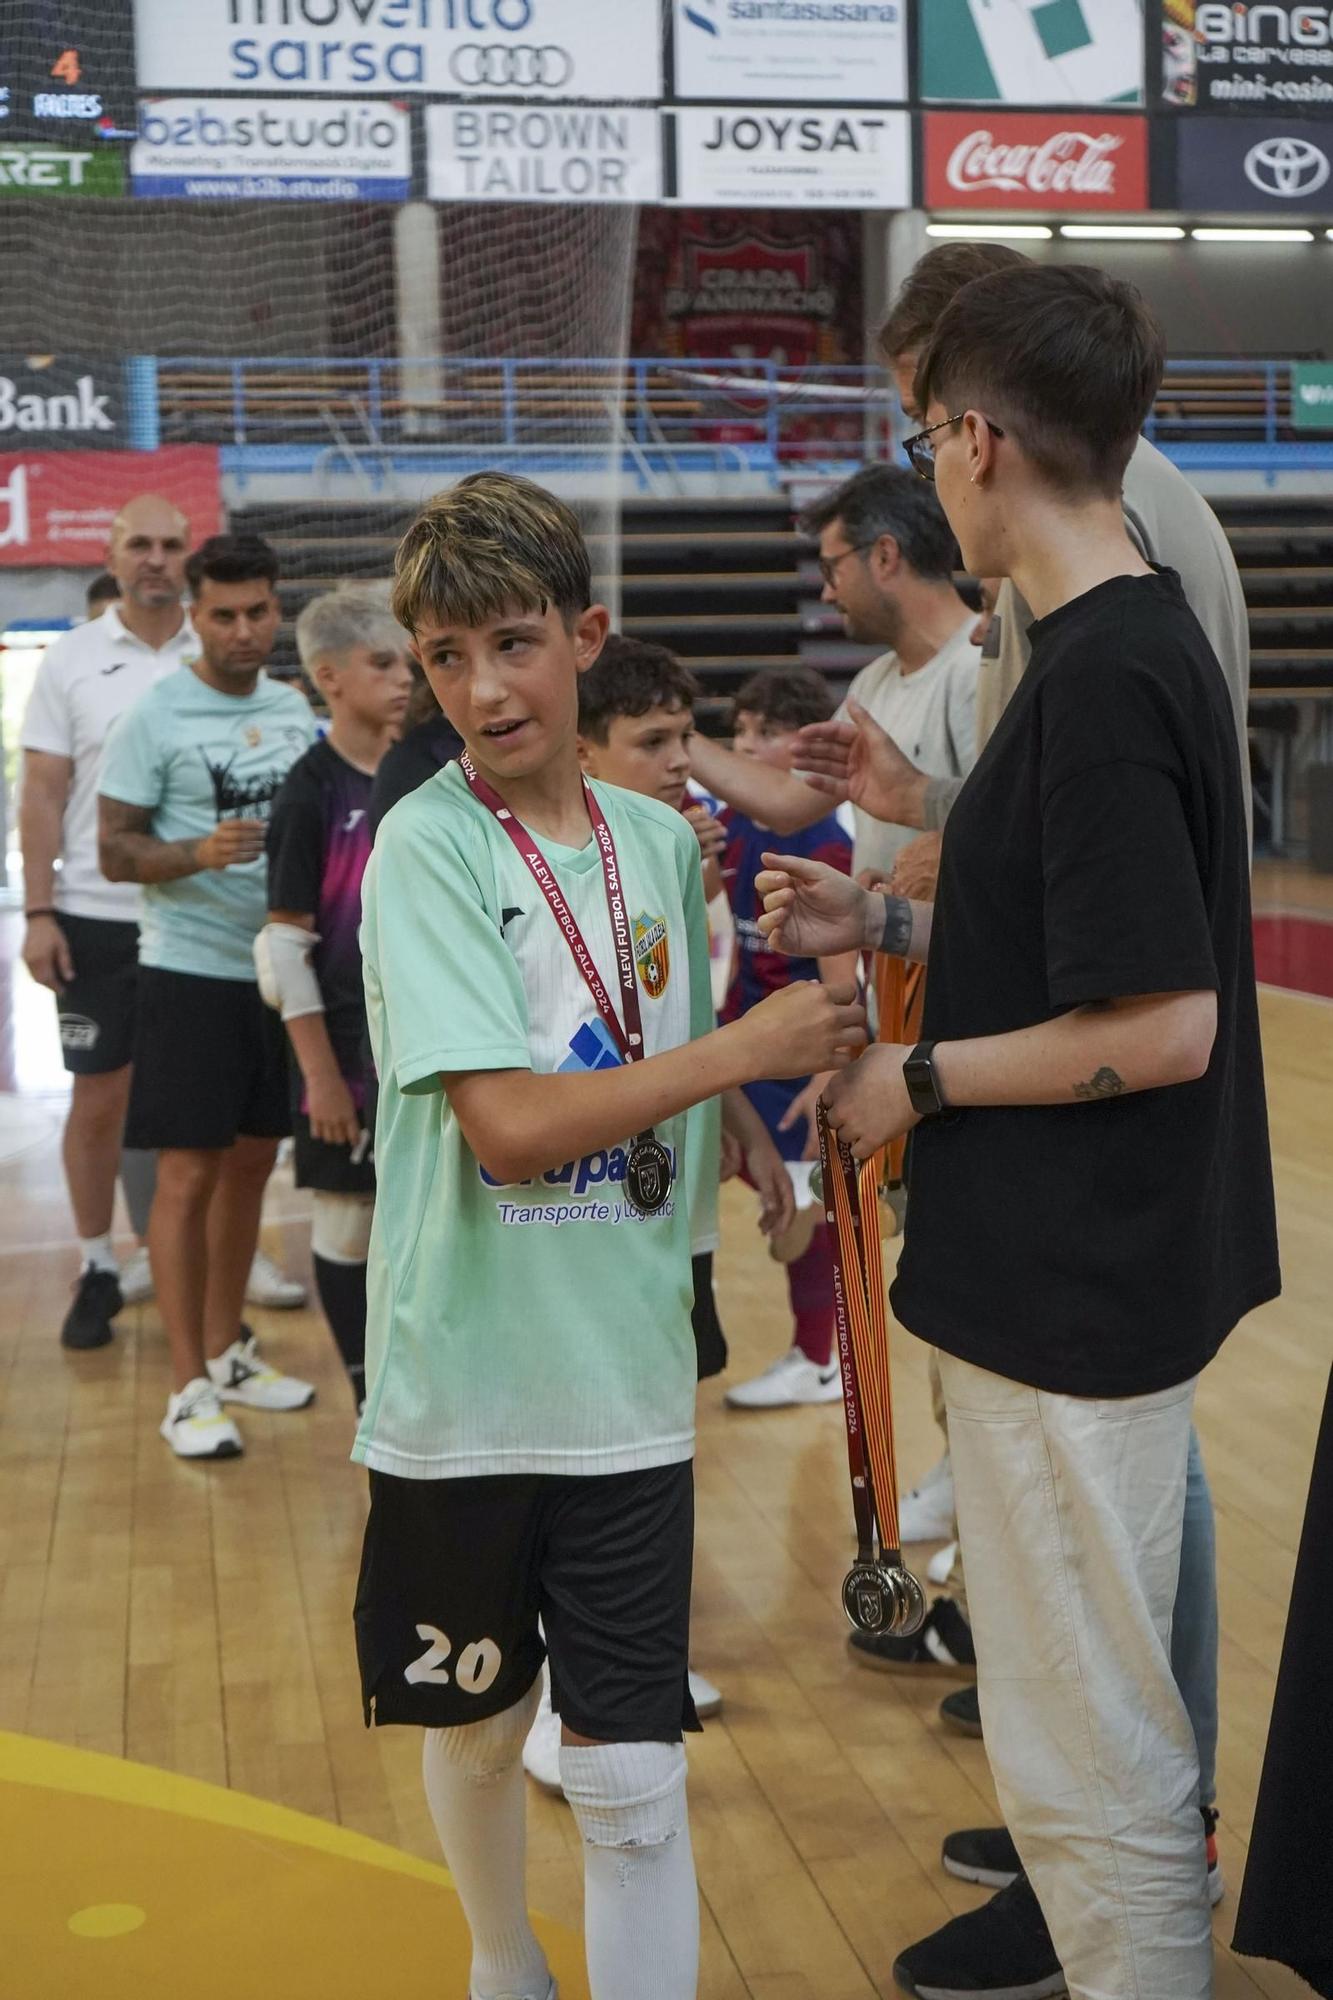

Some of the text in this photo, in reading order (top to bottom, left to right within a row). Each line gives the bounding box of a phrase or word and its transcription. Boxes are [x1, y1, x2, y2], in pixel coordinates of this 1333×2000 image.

[51, 48, 81, 85] 4
[231, 38, 424, 83] sarsa
[453, 111, 628, 150] BROWN
[703, 117, 886, 152] JOYSAT
[456, 155, 627, 195] TAILOR
[946, 130, 1126, 194] Coca-Cola
[0, 375, 116, 431] Bank
[596, 823, 613, 853] 2024
[607, 856, 620, 891] SALA
[611, 893, 628, 946] FUTBOL
[547, 889, 578, 943] FUTBOL
[574, 943, 594, 980] SALA
[591, 981, 610, 1013] 2024
[499, 1202, 609, 1225] Transporte
[614, 1203, 621, 1224] y
[837, 1307, 849, 1360] FUTBOL
[843, 1362, 853, 1398] SALA
[847, 1401, 857, 1435] 2024
[403, 1623, 502, 1694] 20
